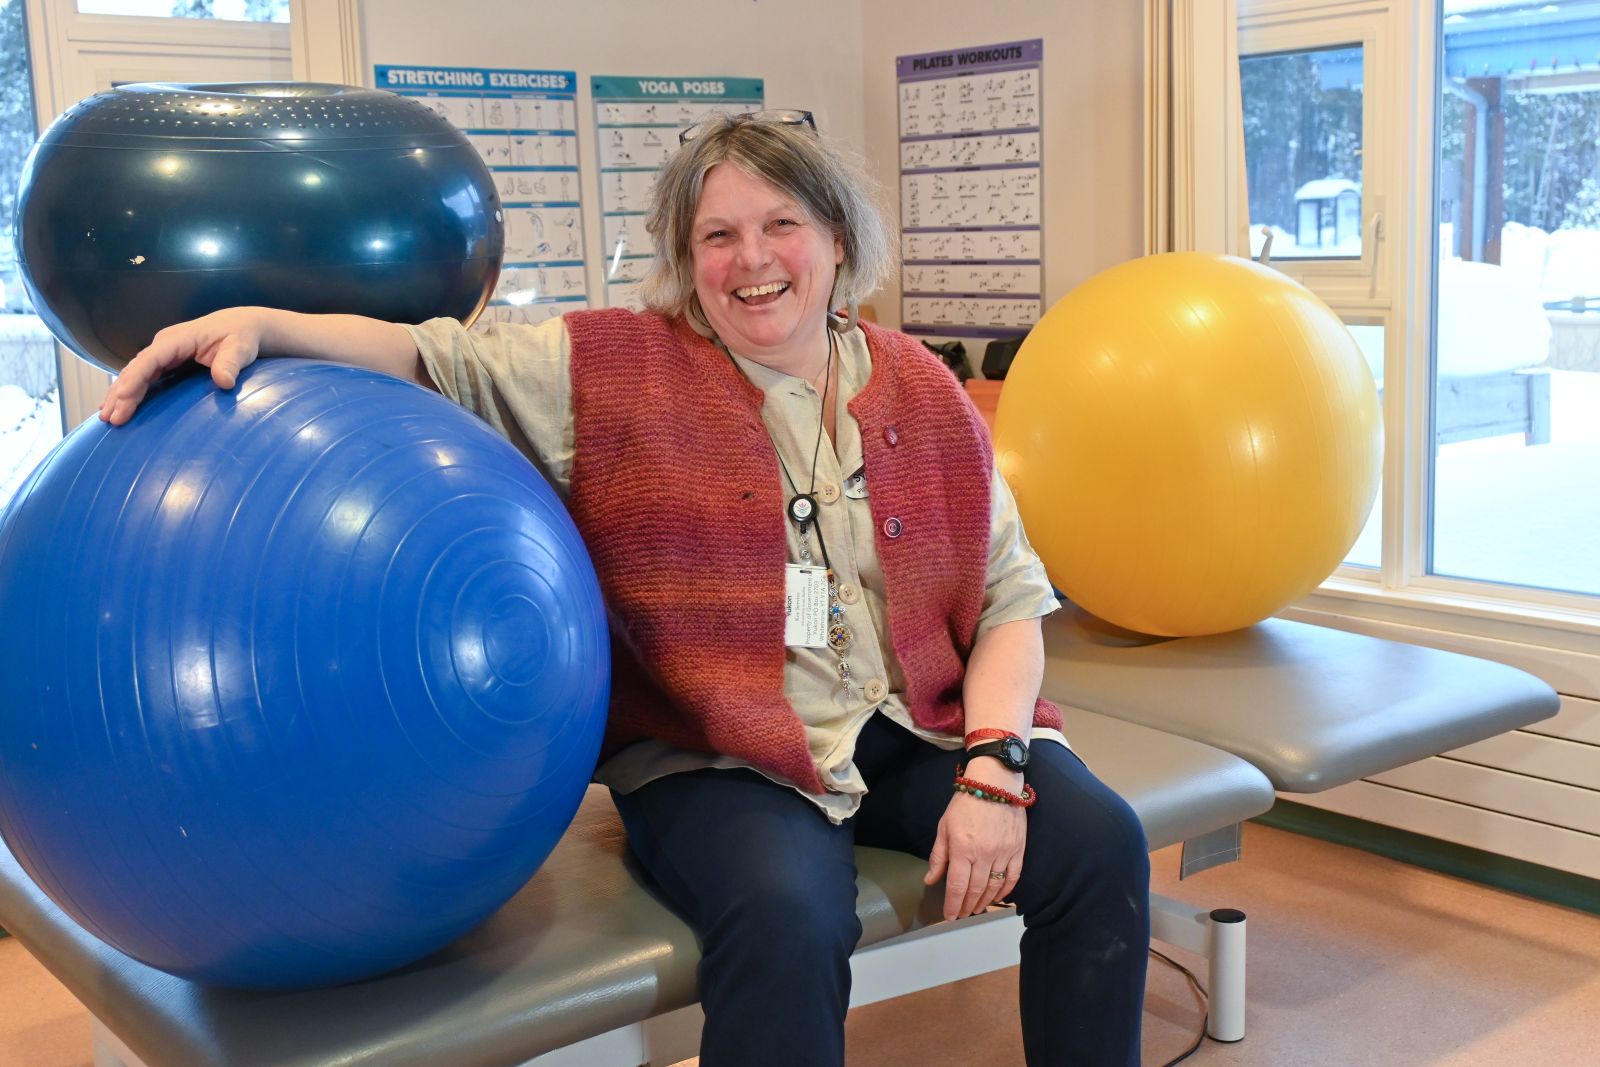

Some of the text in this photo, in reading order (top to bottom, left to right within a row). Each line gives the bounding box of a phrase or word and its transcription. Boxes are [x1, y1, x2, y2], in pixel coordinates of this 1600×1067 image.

[912, 46, 1022, 71] PILATES WORKOUTS
[387, 69, 567, 89] STRETCHING EXERCISES
[638, 81, 725, 95] YOGA POSES
